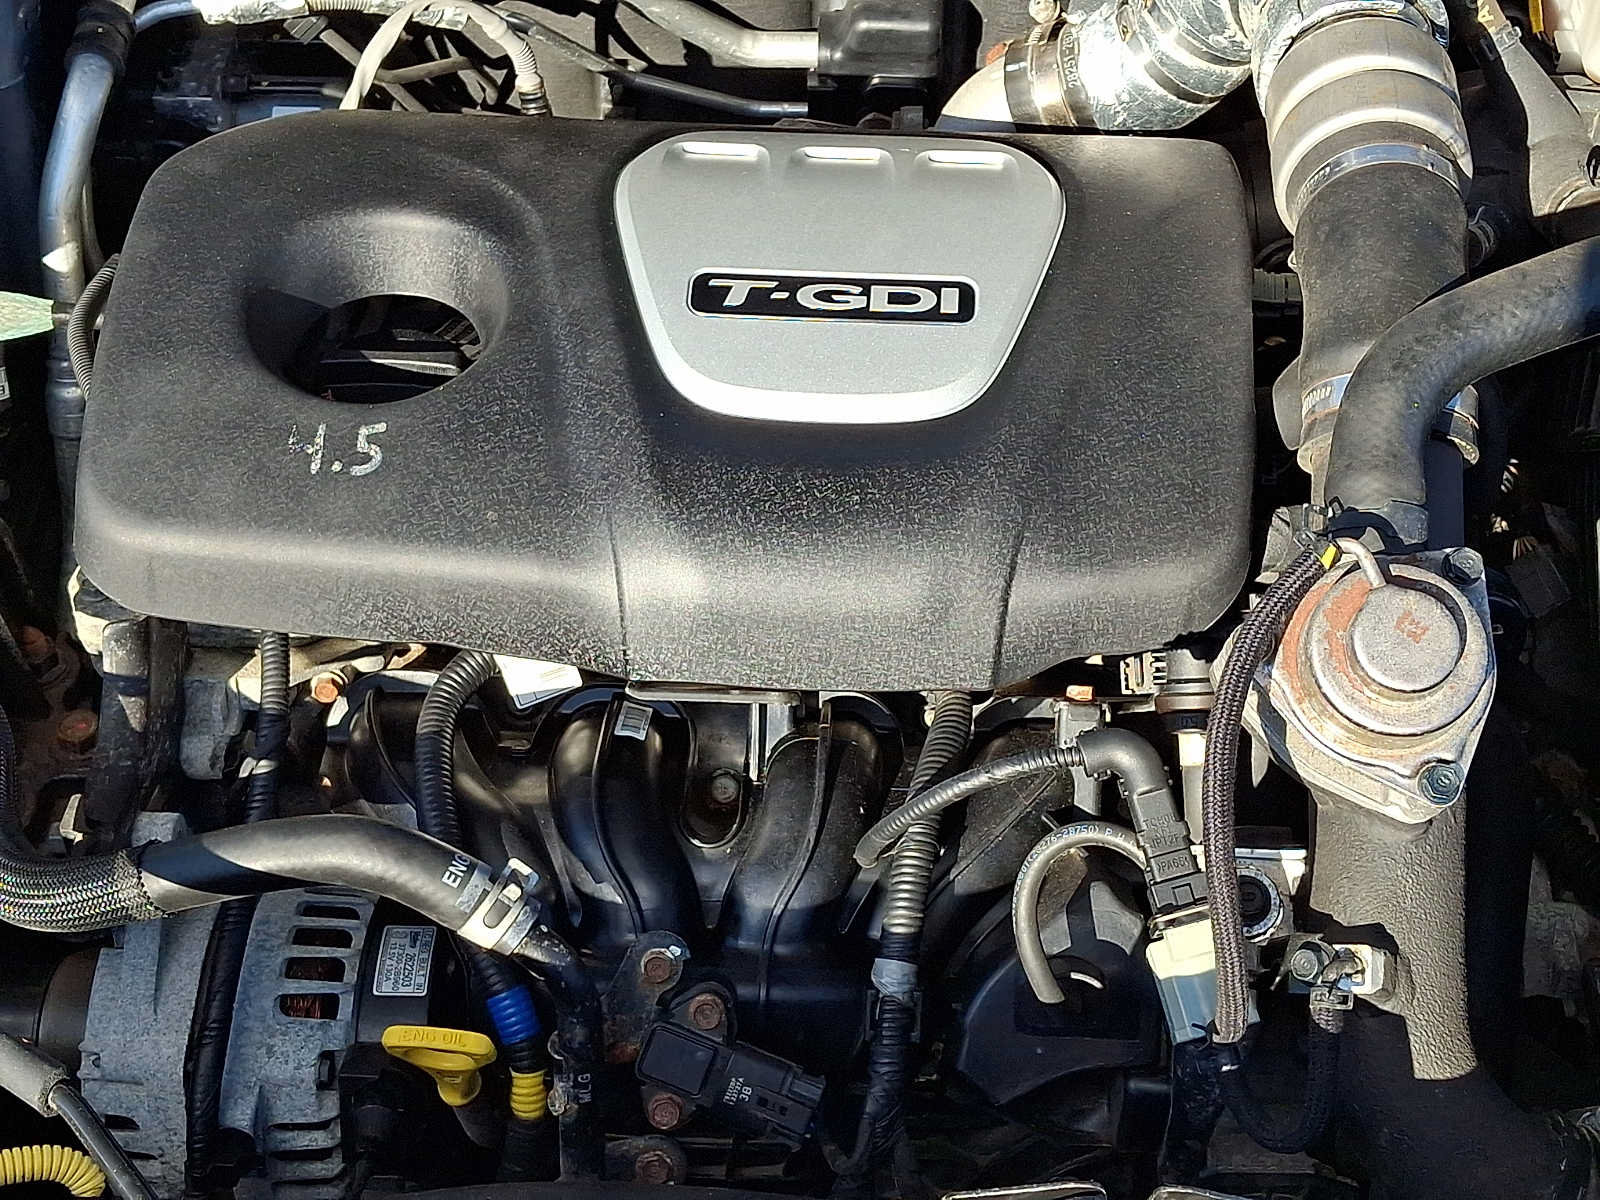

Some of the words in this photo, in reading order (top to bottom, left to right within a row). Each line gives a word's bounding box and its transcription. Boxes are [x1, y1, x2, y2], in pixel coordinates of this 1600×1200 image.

[708, 278, 960, 314] T-GDI
[288, 422, 388, 476] 4.5
[441, 853, 471, 889] ENG
[401, 952, 416, 988] 2622503
[398, 1029, 437, 1043] ENG
[442, 1031, 467, 1047] OIL
